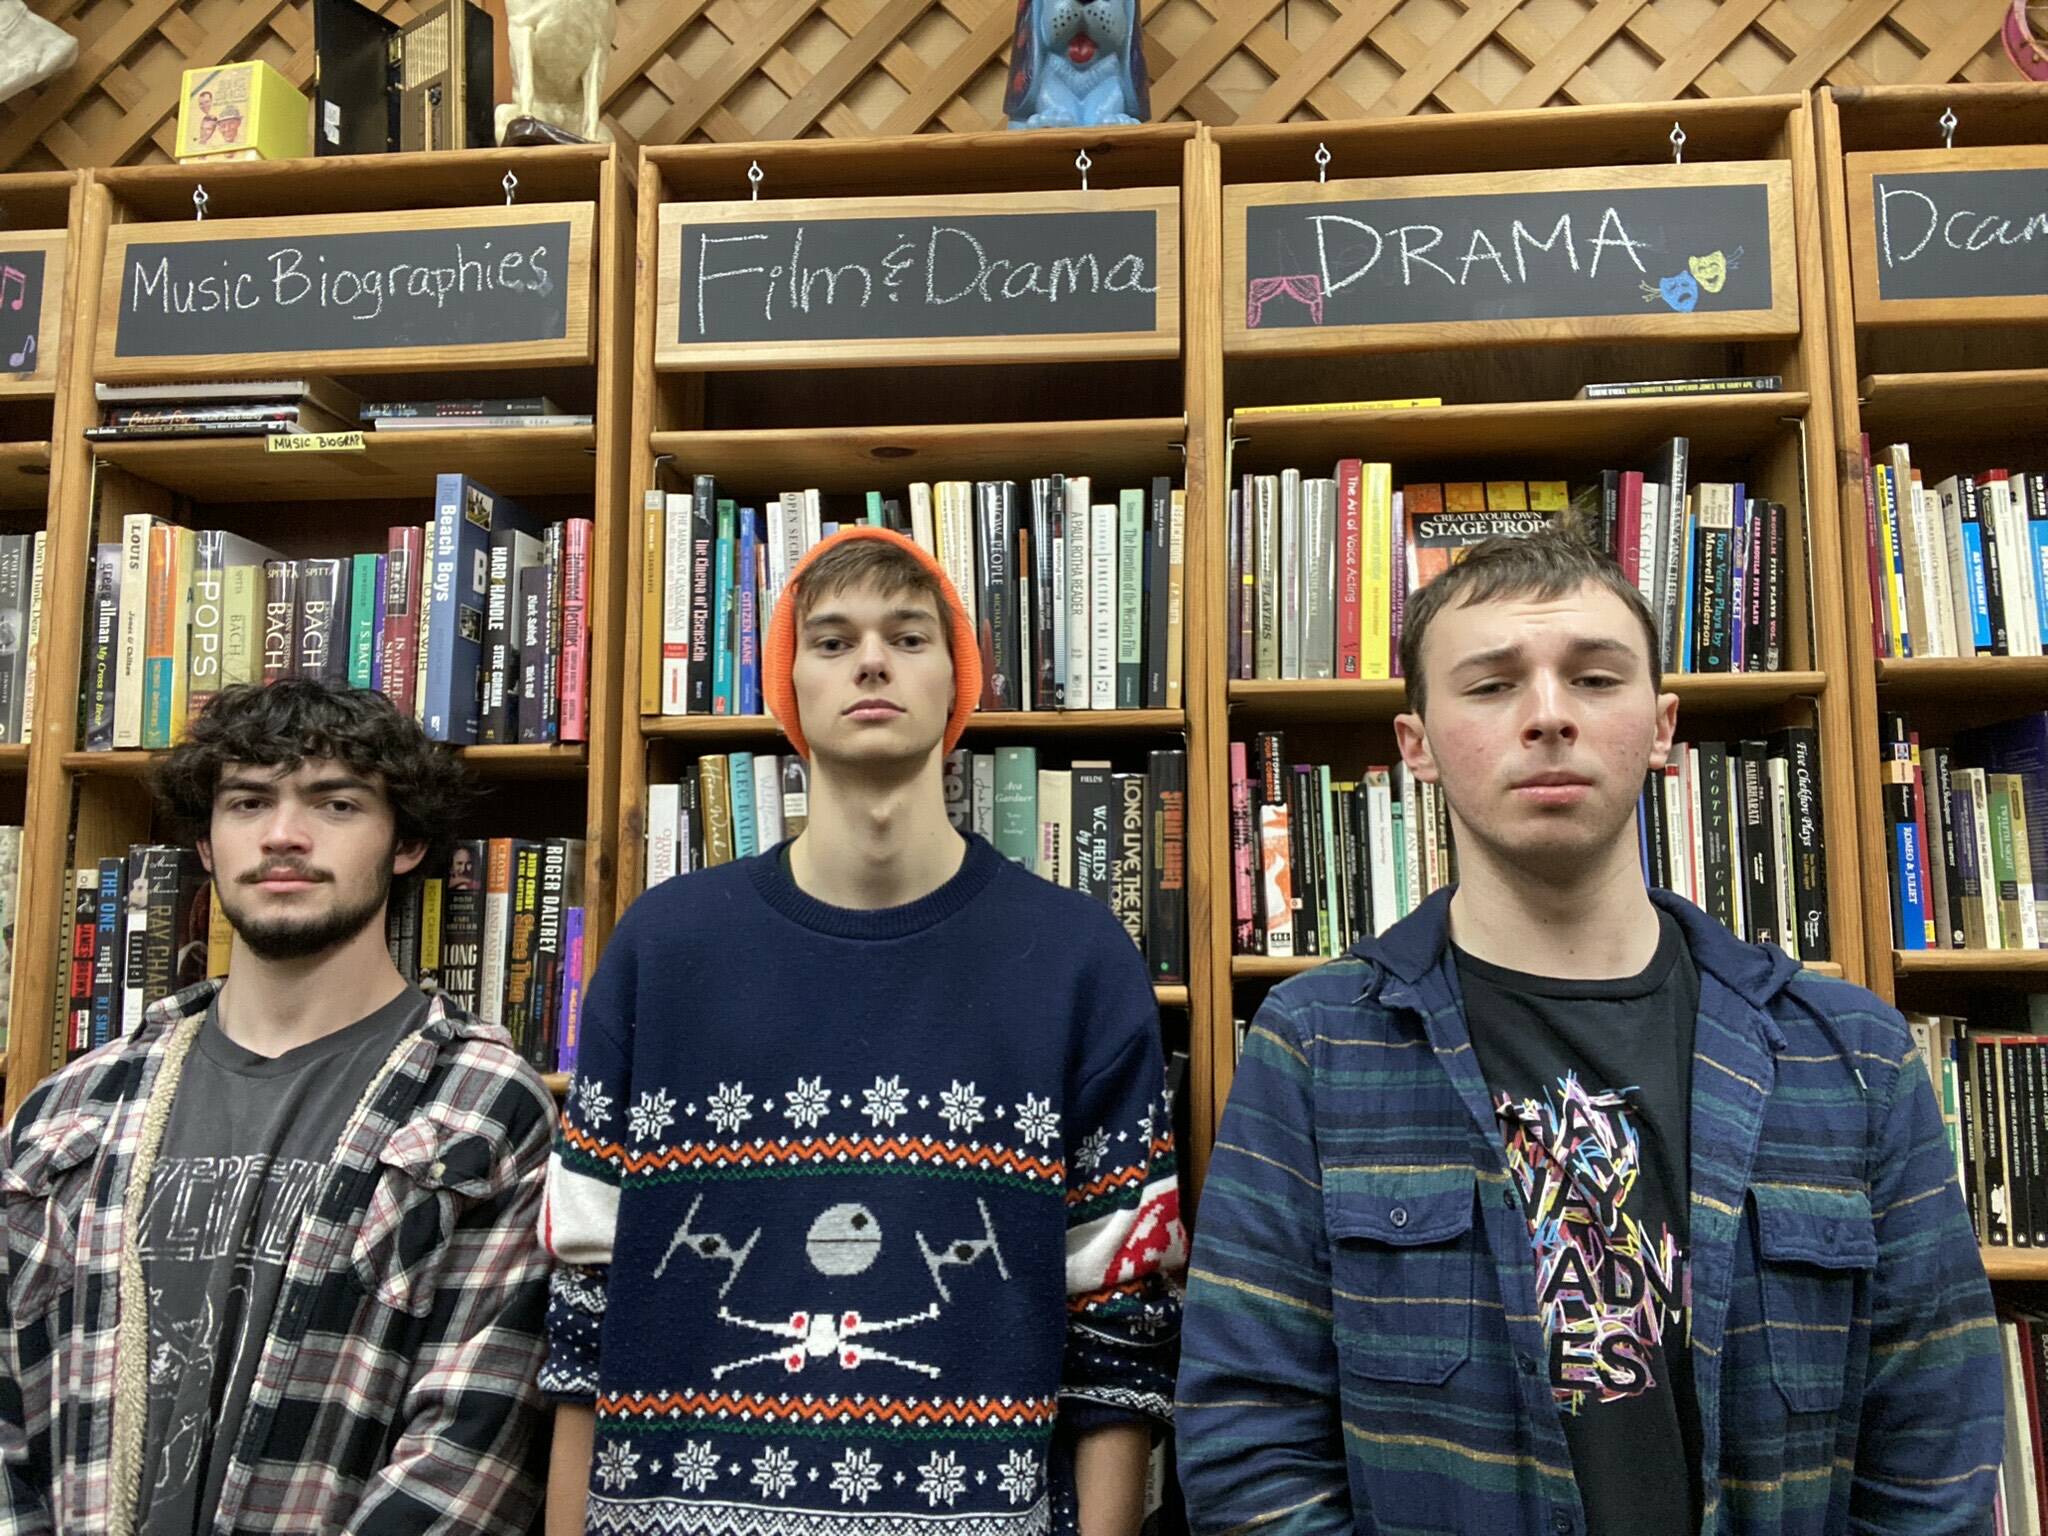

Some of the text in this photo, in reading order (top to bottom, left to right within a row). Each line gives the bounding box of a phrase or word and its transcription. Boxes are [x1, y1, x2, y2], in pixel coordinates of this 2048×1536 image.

[1304, 207, 1648, 298] DRAMA
[132, 241, 549, 320] Music Biographies
[701, 225, 1161, 334] Film & Drama
[273, 436, 312, 450] MUSIC
[1346, 499, 1358, 517] Art
[1347, 475, 1359, 497] The
[1965, 478, 1977, 518] NO FEAR
[2035, 475, 2047, 516] NO FEAR
[1346, 518, 1358, 531] of
[1432, 511, 1543, 522] CREATE YOUR OWN
[129, 525, 142, 570] LOUIS
[433, 504, 457, 602] Beach Boys
[695, 539, 710, 556] The
[990, 539, 1003, 586] PEOPLE
[1070, 511, 1084, 616] A PAUL ROTHA READER
[1346, 534, 1358, 565] Voice
[387, 560, 400, 604] BACH
[488, 546, 508, 631] HARD HANDLE
[675, 510, 688, 631] THE MAKING OF CASABLANCA
[694, 557, 710, 592] Cinema
[1121, 528, 1138, 657] The Invention of the Western Film
[1345, 567, 1358, 603] Acting
[1702, 531, 1716, 647] Maxwell Anderson
[1711, 532, 1728, 648] Four Verse Plays by
[1752, 577, 1761, 597] FIVE
[1973, 551, 1987, 616] AS YOU LIKE IT
[563, 552, 585, 648] Hollywood Destinies
[693, 597, 709, 609] of
[1262, 583, 1272, 640] PLAYERS
[1733, 576, 1742, 619] BECKET
[1752, 600, 1760, 625] PLAYS
[193, 580, 219, 677] POPS
[229, 614, 244, 656] BACH
[264, 601, 285, 668] BACH
[302, 600, 324, 668] BACH
[692, 609, 709, 662] Eisenstein
[741, 591, 752, 666] CITIZEN KANE
[419, 636, 430, 672] WITH
[490, 644, 505, 707] STEVE GORMAN
[94, 644, 108, 726] My Cross to Bear
[701, 761, 723, 801] Home
[1080, 774, 1104, 783] FIELDS
[1264, 736, 1274, 802] FOUR COMEDIES
[1271, 736, 1282, 802] ARISTOPHANES
[994, 791, 1034, 803] Gardner
[1123, 779, 1142, 830] LONG
[1745, 760, 1760, 826] MAHABHARATA
[1796, 741, 1815, 847] Five Chekhov Plays
[1092, 804, 1107, 882] W.C. FIELDS
[1427, 815, 1435, 833] TAPE
[2000, 804, 2013, 872] TWELFTH NIGHT
[496, 844, 507, 889] CROSBY
[517, 858, 526, 876] CARL
[543, 845, 564, 890] ROGER
[1123, 832, 1142, 872] LIVE
[1903, 826, 1918, 905] ROMEO & JULIET
[99, 868, 118, 933] THE ONE
[515, 877, 524, 912] GOTTLIEB
[525, 852, 538, 910] DAVID CROSBY
[1123, 873, 1141, 908] THE
[488, 898, 500, 933] STAND
[512, 913, 535, 961] Since
[538, 895, 561, 954] DALTREY
[443, 943, 478, 966] LONG
[488, 935, 498, 964] AND
[443, 968, 476, 991] TIME
[486, 968, 497, 983] BE
[508, 962, 531, 1003] Then
[1965, 1095, 1973, 1122] PERFECT
